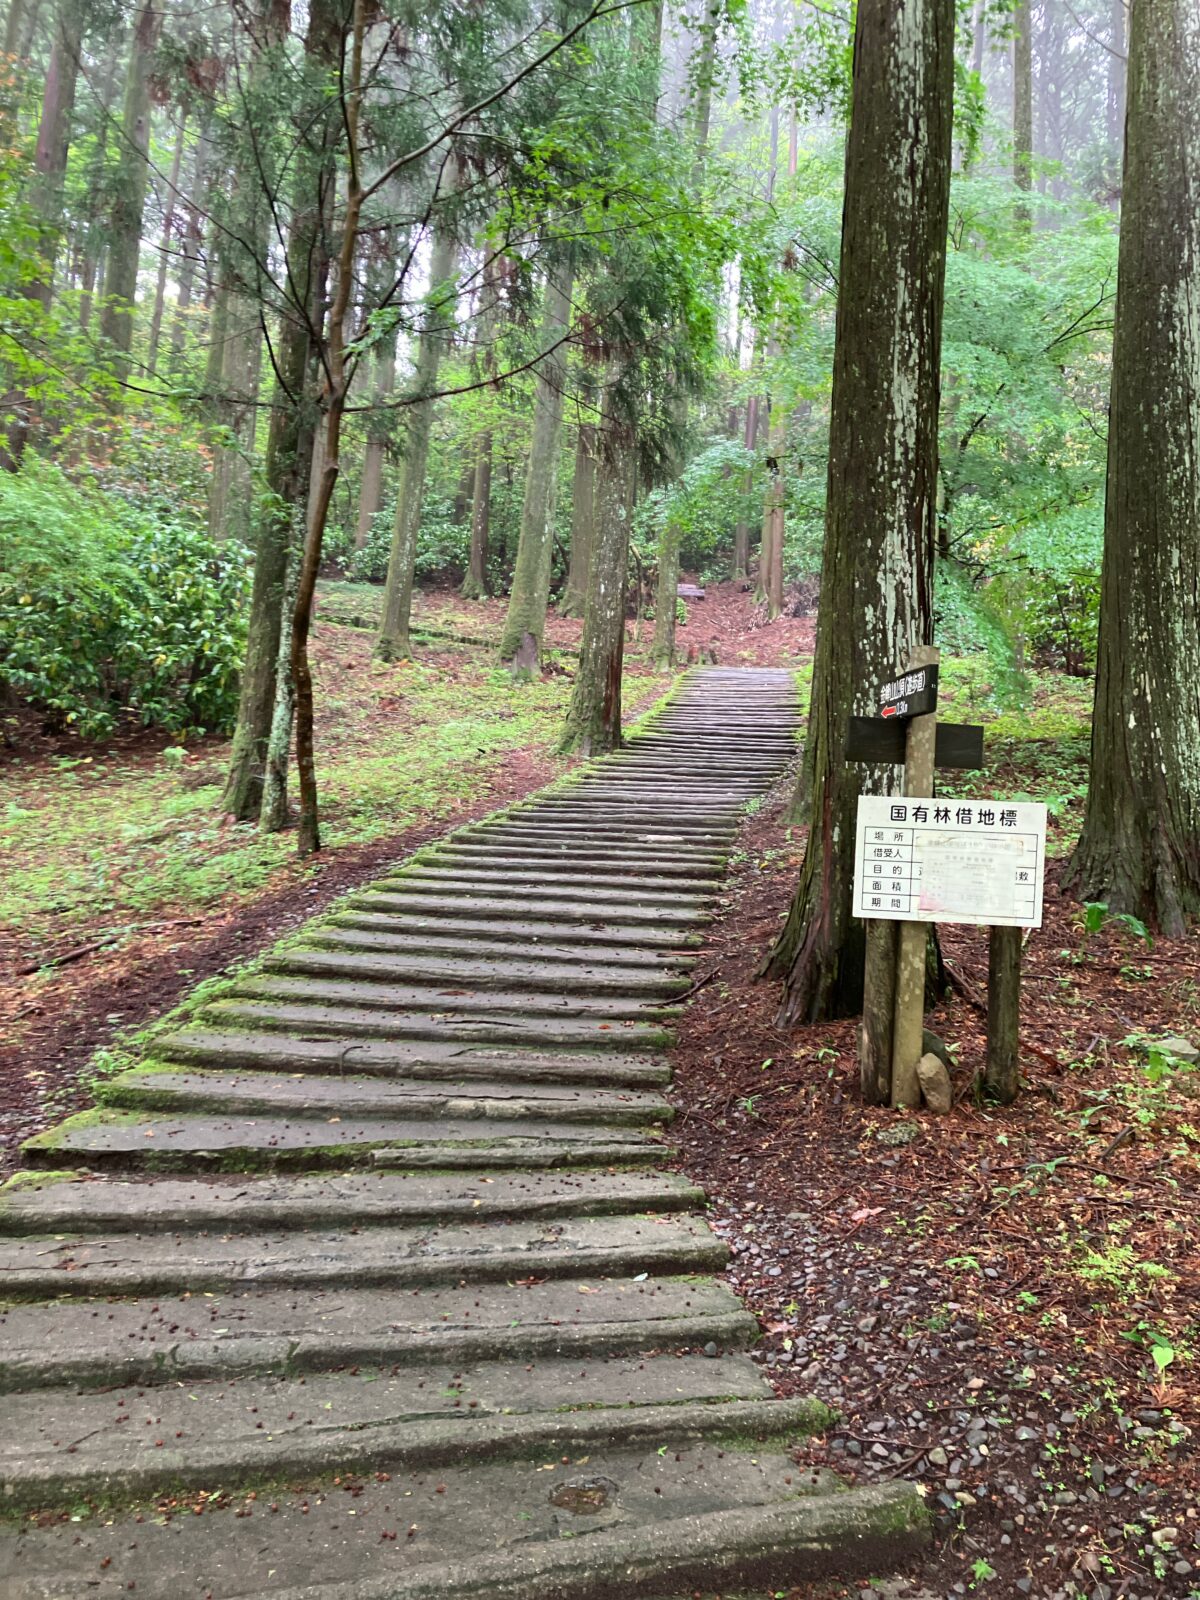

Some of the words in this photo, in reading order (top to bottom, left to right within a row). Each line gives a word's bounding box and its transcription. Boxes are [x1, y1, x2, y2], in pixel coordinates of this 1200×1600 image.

[891, 805, 1018, 827] 国有林借地標
[873, 848, 903, 858] 借受人
